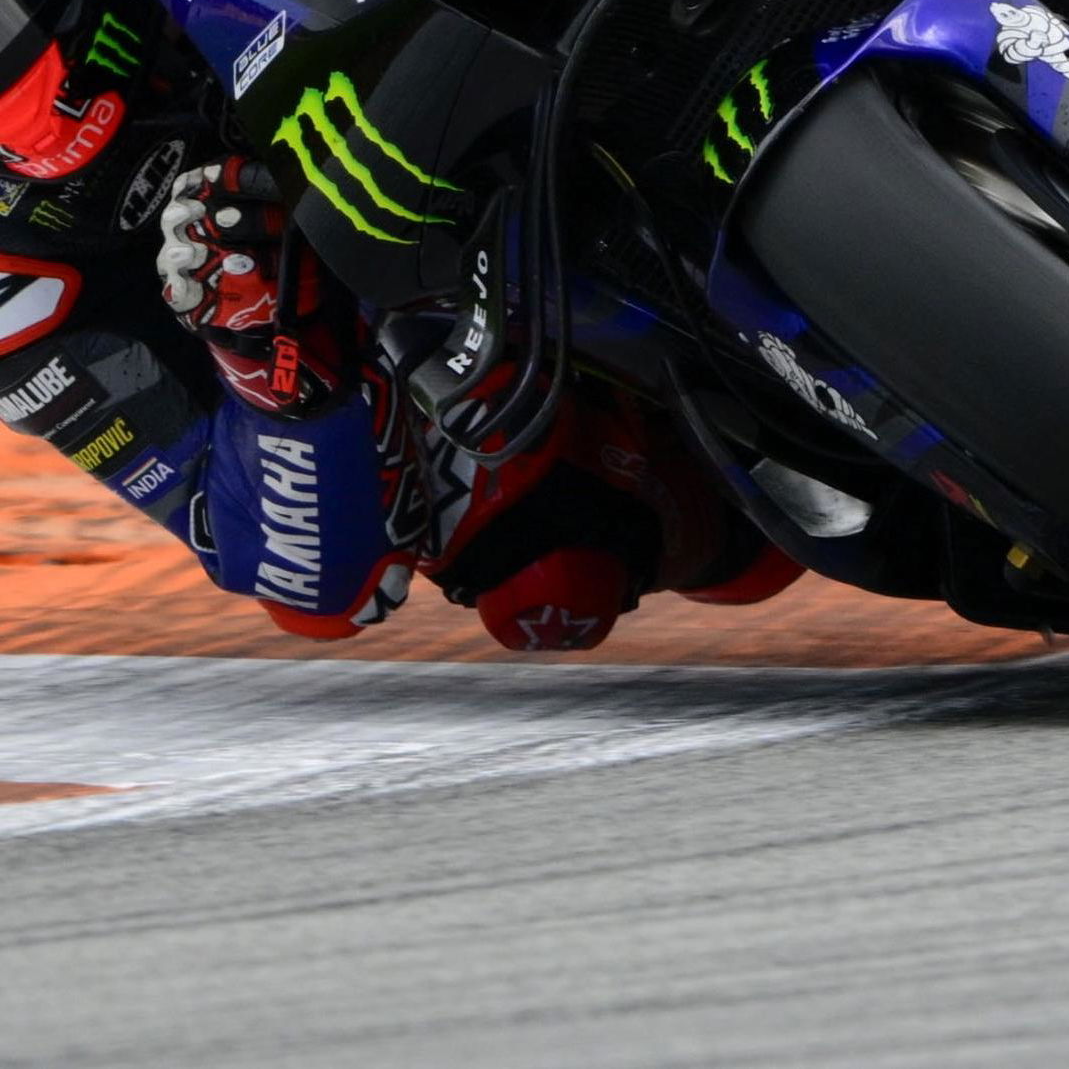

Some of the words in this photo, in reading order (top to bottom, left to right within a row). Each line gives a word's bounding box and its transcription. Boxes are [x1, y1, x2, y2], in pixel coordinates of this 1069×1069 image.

[123, 143, 183, 228] HJC
[127, 462, 175, 500] INDIA
[255, 434, 322, 610] YAMAHA
